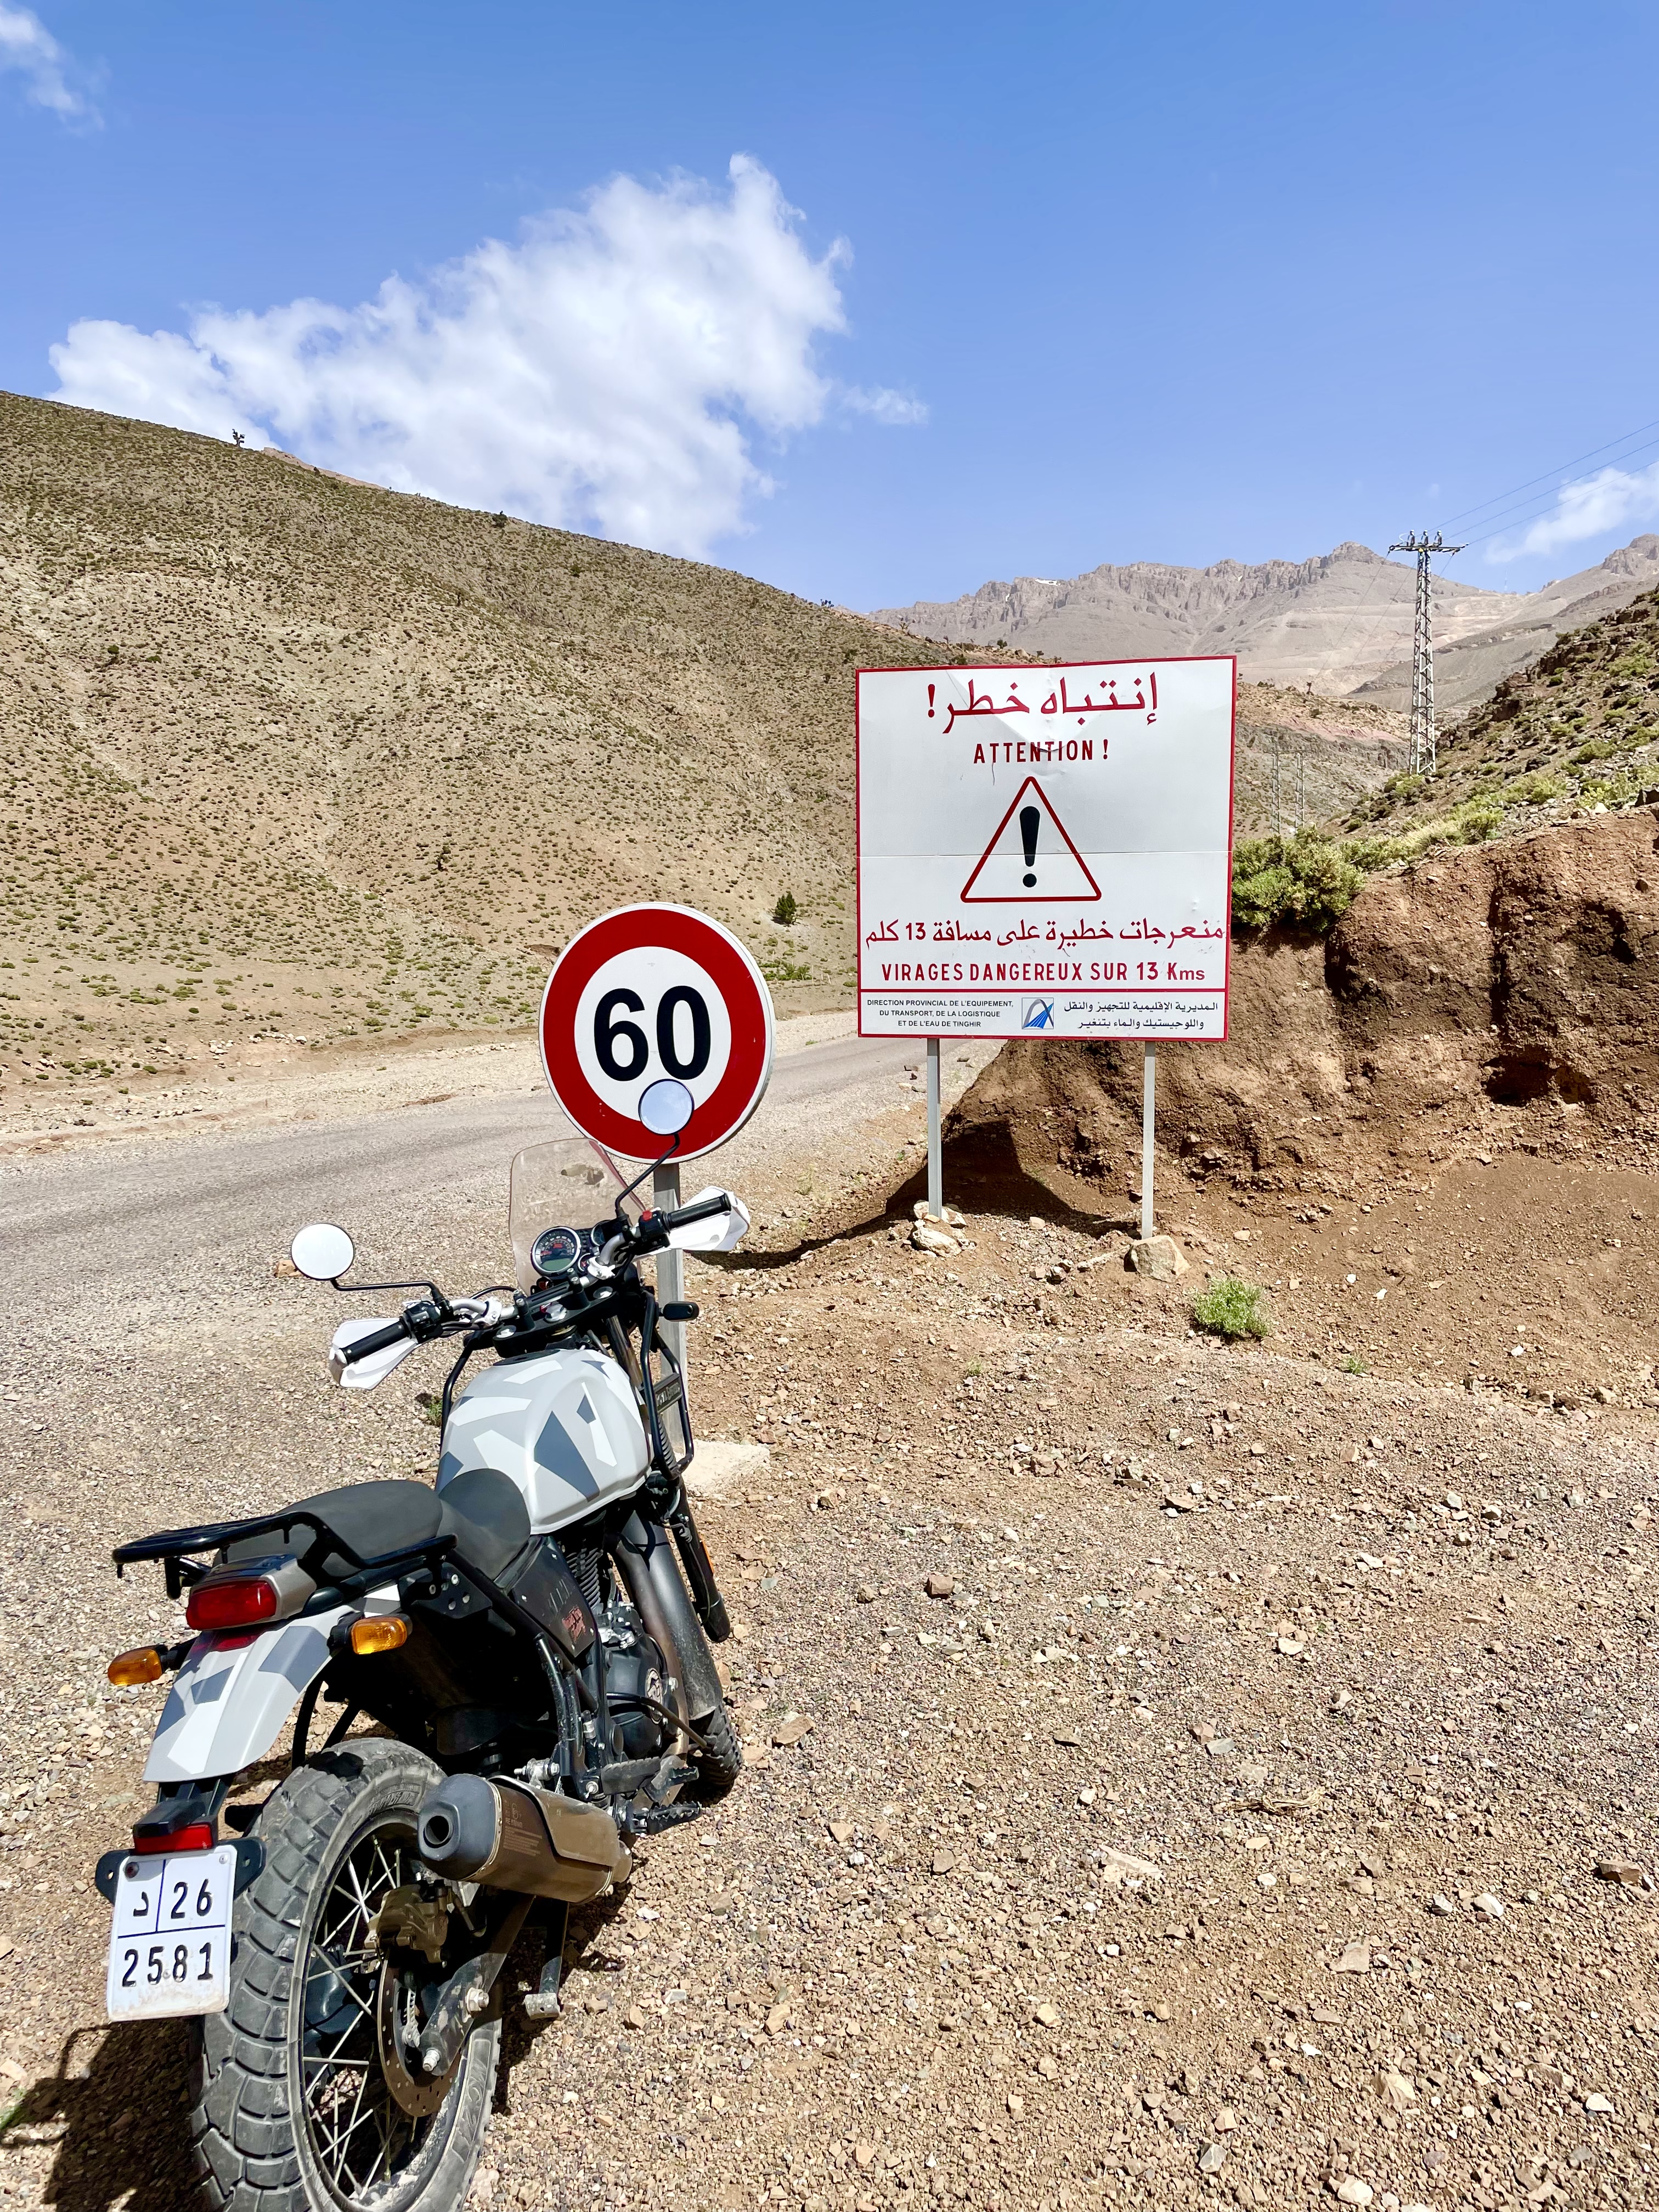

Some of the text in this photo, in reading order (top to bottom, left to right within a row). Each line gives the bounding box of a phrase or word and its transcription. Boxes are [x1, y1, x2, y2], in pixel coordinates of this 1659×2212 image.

[973, 740, 1093, 764] ATTENTION
[866, 917, 1221, 950] منعرجات خطيرة على مسافة 13 كلم
[882, 962, 1205, 981] VIRAGES DANGEREUX SUR 13 Kms
[1064, 1001, 1093, 1012] والنقل
[1096, 1001, 1130, 1012] للتجهيز
[1175, 1001, 1218, 1013] المديرية
[1078, 1018, 1111, 1029] بتنغير
[1114, 1018, 1141, 1029] والماء
[594, 985, 712, 1082] 60
[171, 1878, 212, 1920] 26
[122, 1942, 213, 1988] 2581
